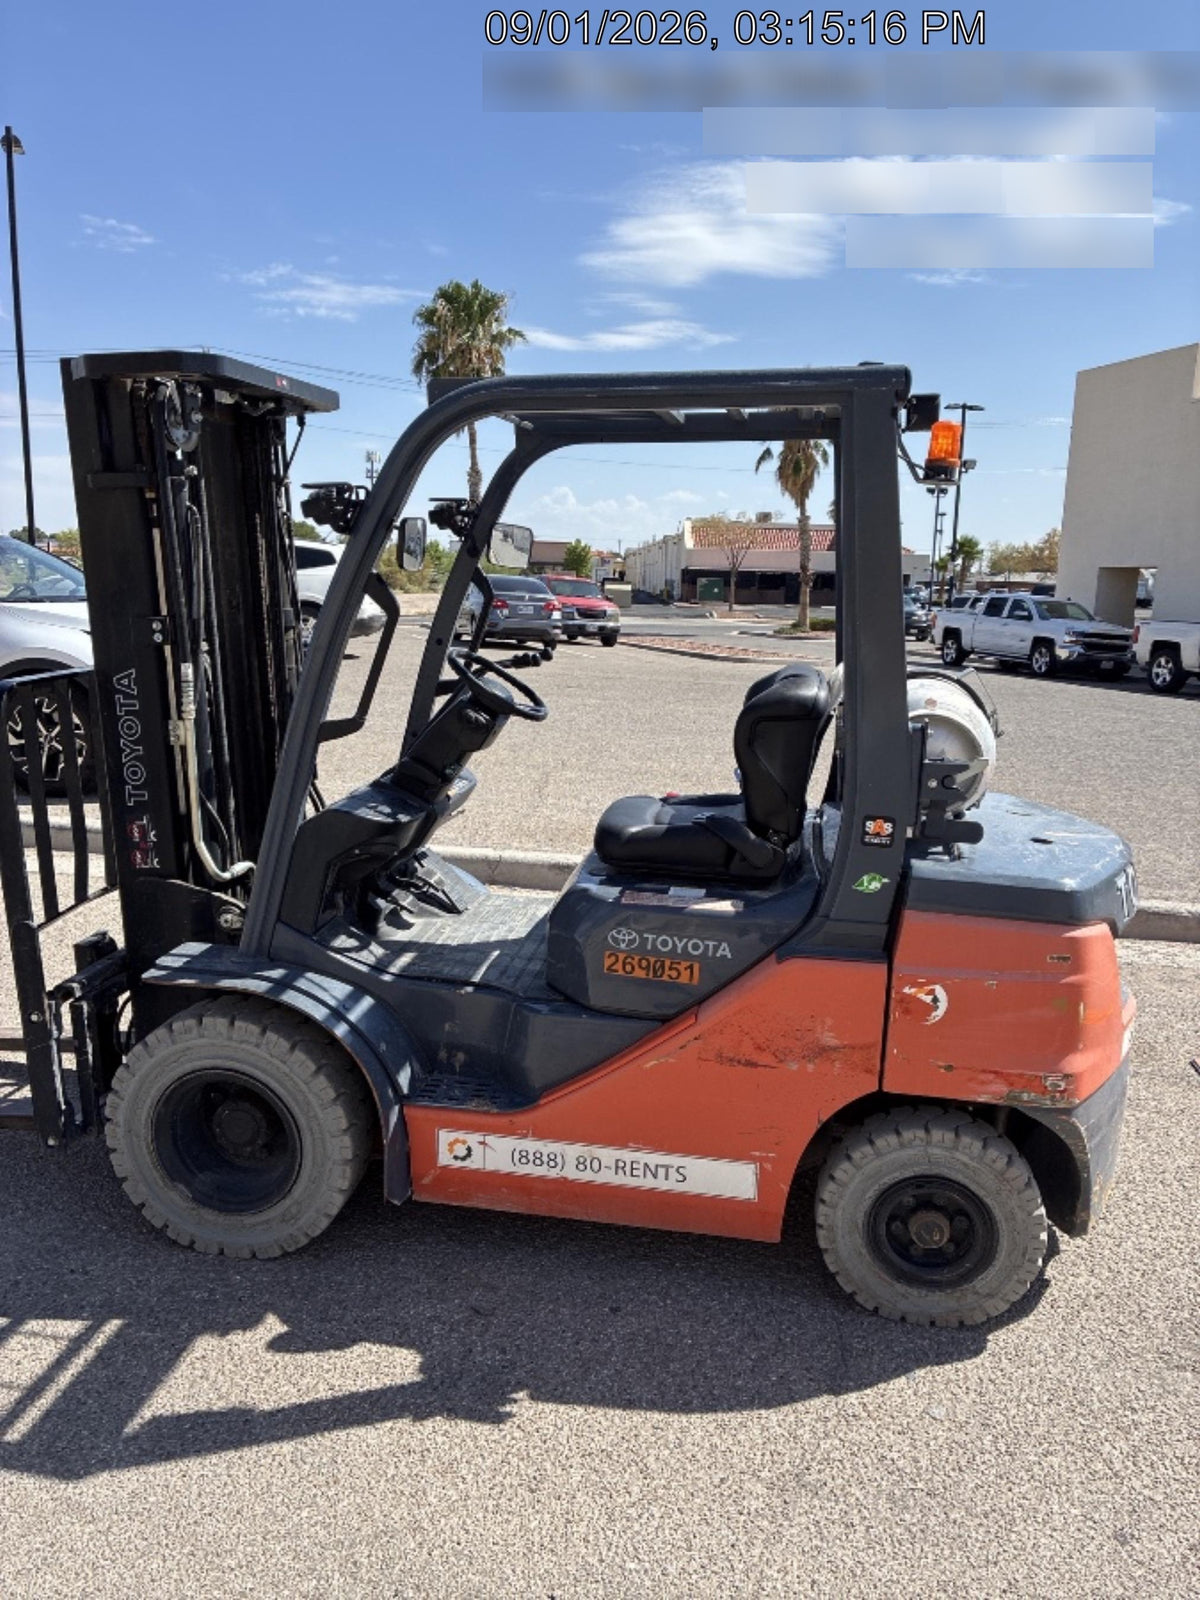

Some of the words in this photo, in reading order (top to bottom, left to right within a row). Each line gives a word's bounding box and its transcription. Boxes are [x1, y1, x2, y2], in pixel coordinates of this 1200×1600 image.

[113, 668, 148, 806] TOYOTA
[865, 819, 894, 836] SAS
[643, 933, 732, 959] TOYOTA
[605, 952, 695, 982] 269051
[510, 1148, 566, 1173] (888)
[575, 1156, 688, 1183] 80-RENTS
